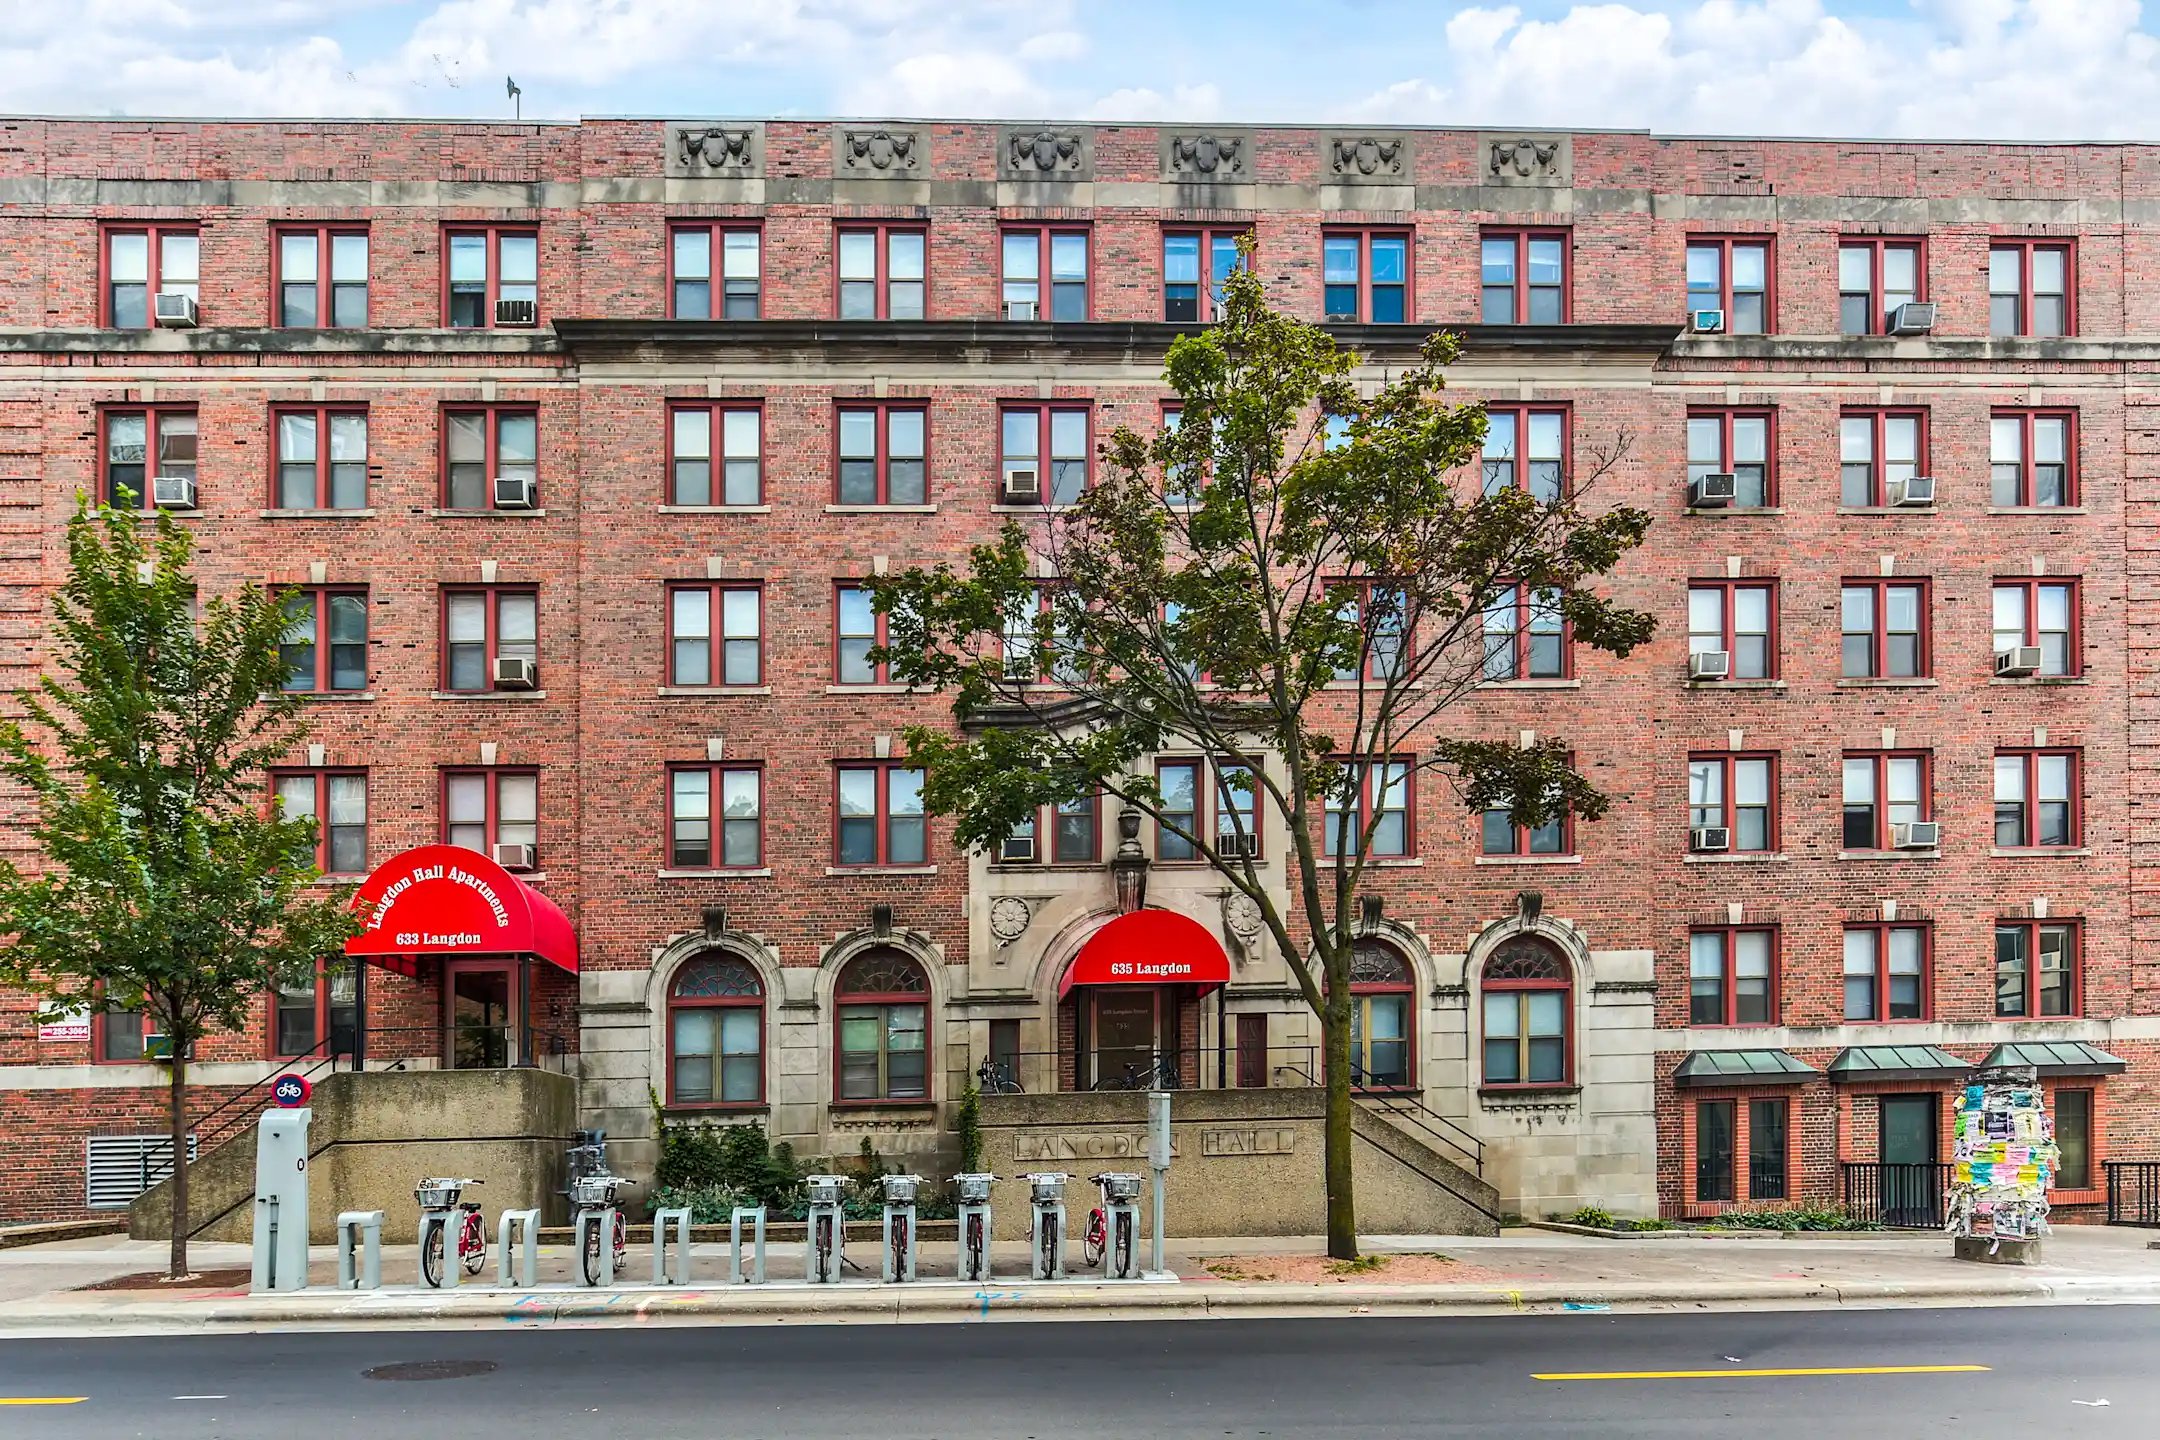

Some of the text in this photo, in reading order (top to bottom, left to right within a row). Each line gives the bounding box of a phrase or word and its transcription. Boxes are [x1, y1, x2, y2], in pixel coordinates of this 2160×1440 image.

[367, 865, 509, 930] Langdon Hall Apartments
[396, 932, 481, 946] 633 Langdon
[1111, 962, 1191, 976] 635 Langdon
[1204, 1131, 1291, 1153] HALL
